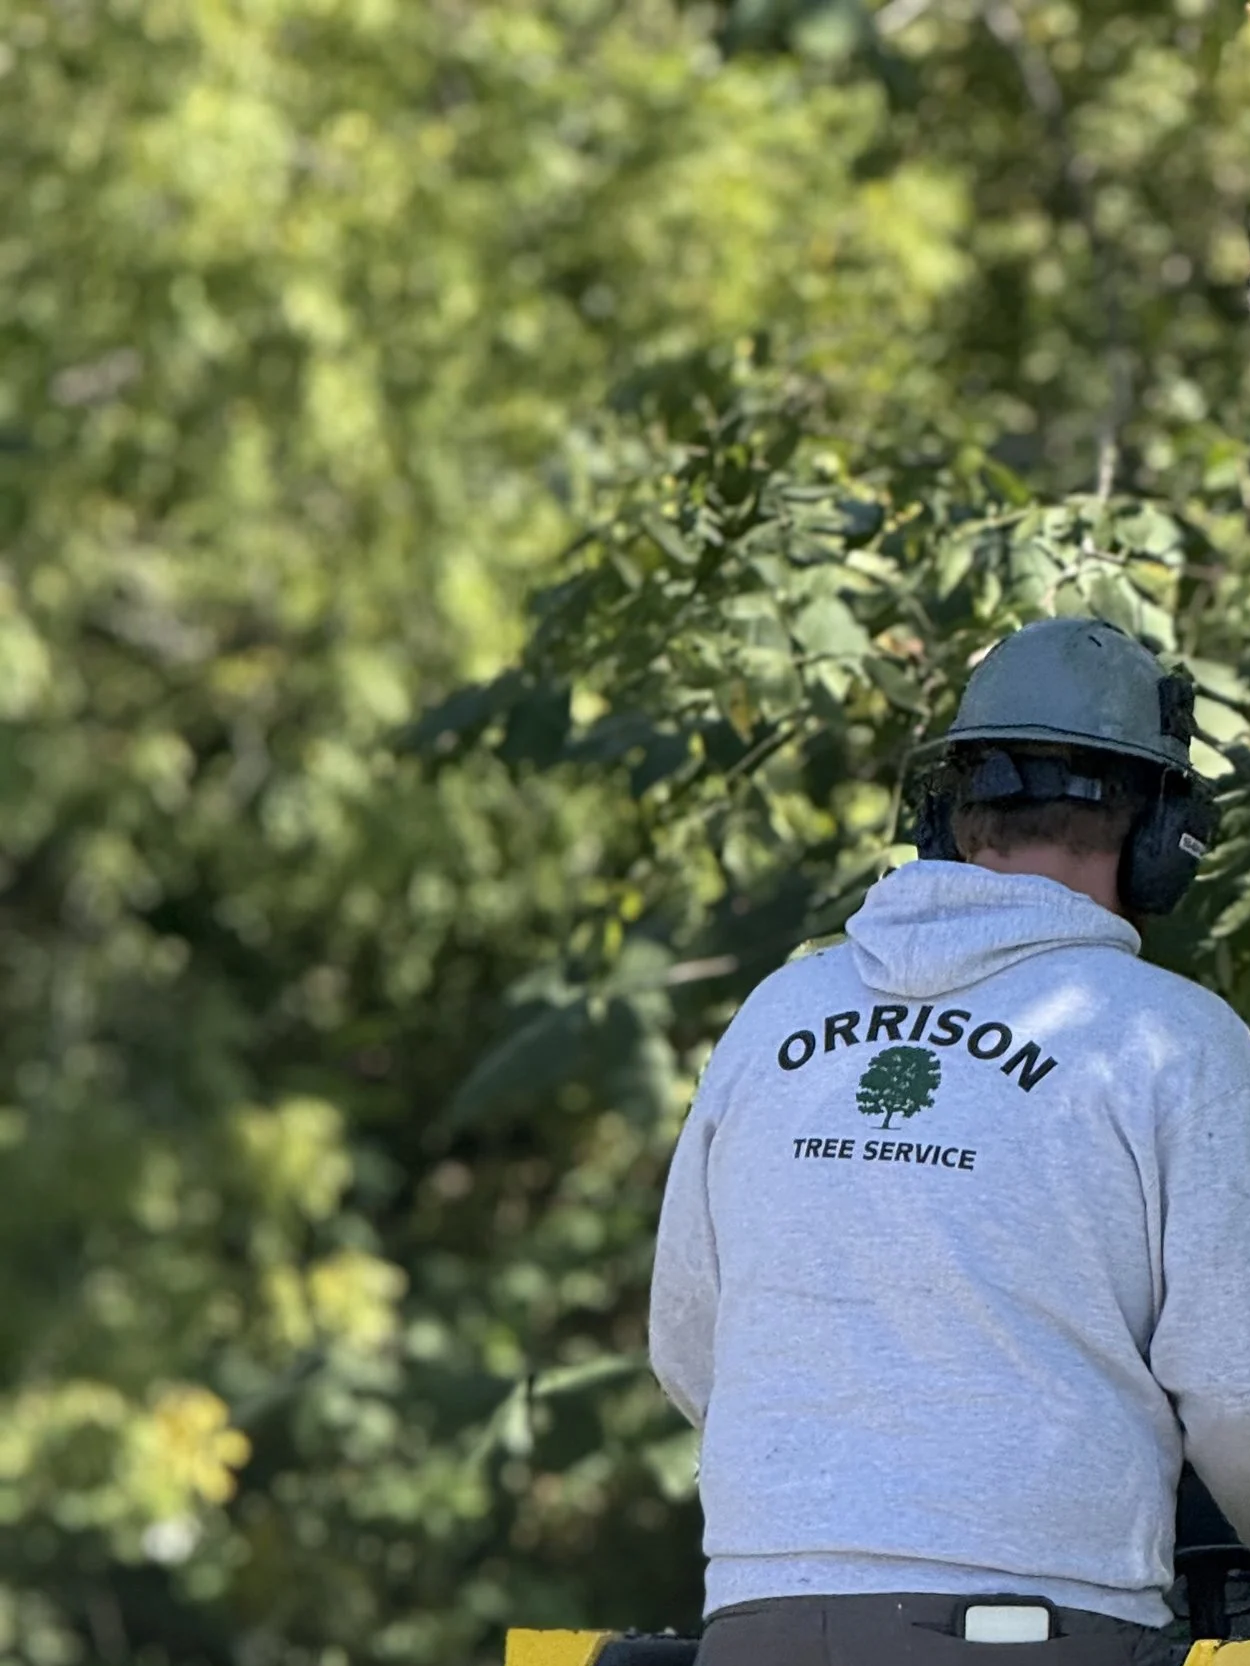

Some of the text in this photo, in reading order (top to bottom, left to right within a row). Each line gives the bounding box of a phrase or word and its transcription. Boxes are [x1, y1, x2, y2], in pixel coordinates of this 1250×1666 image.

[777, 1004, 1058, 1092] ORRISON
[793, 1137, 977, 1171] TREE SERVICE
